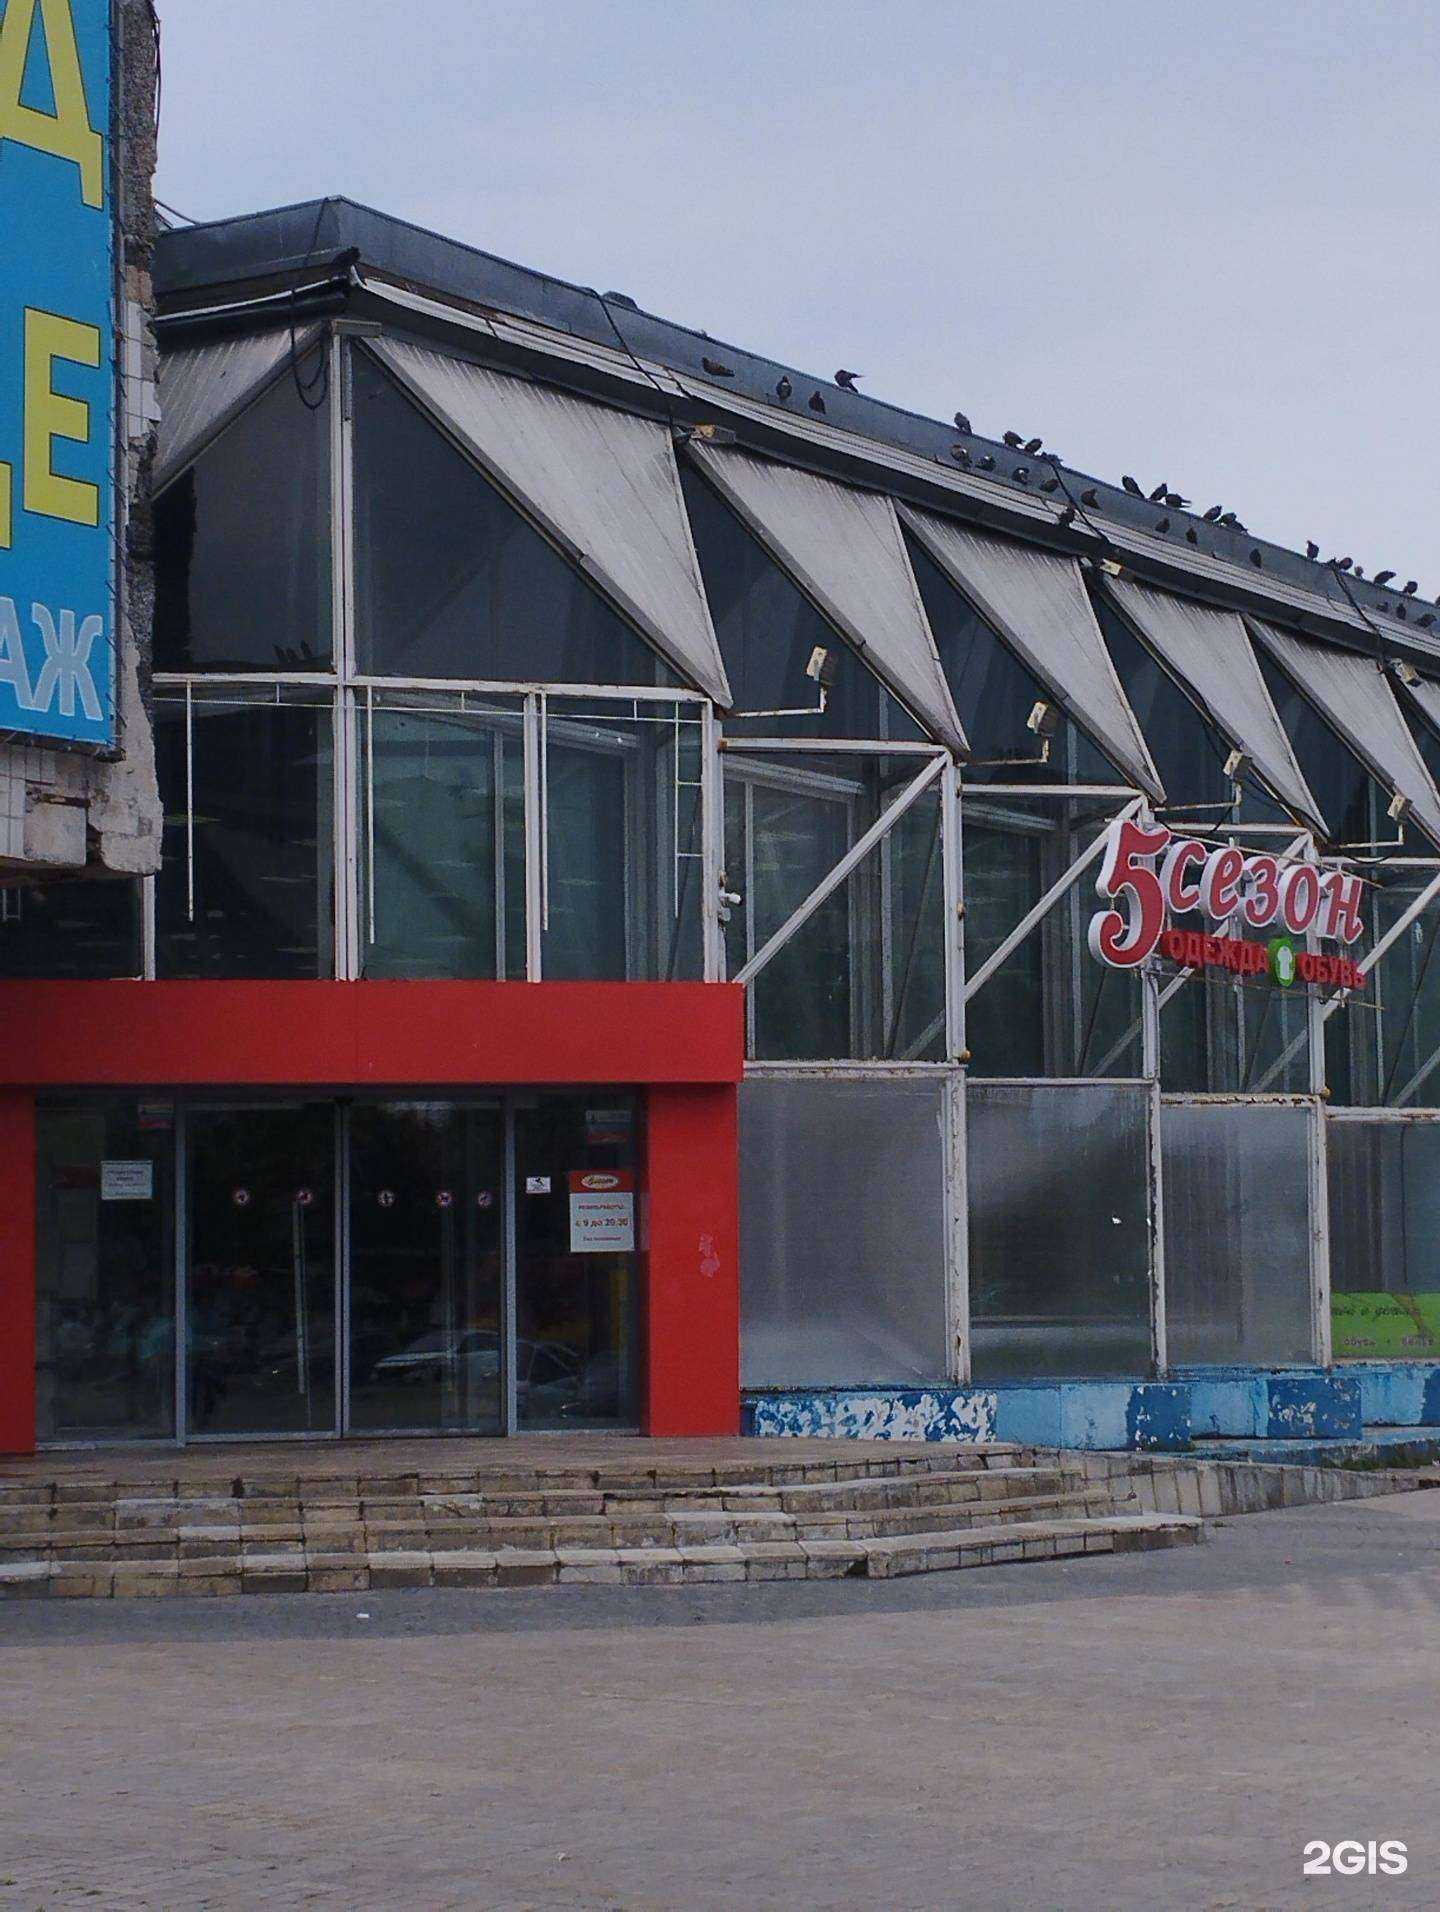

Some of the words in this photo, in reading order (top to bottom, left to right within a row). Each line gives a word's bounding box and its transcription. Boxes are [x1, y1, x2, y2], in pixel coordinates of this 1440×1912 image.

[1089, 819, 1171, 968] 5
[1162, 929, 1270, 976] ОДЕЖДА
[1297, 952, 1367, 989] ОБУВЬ
